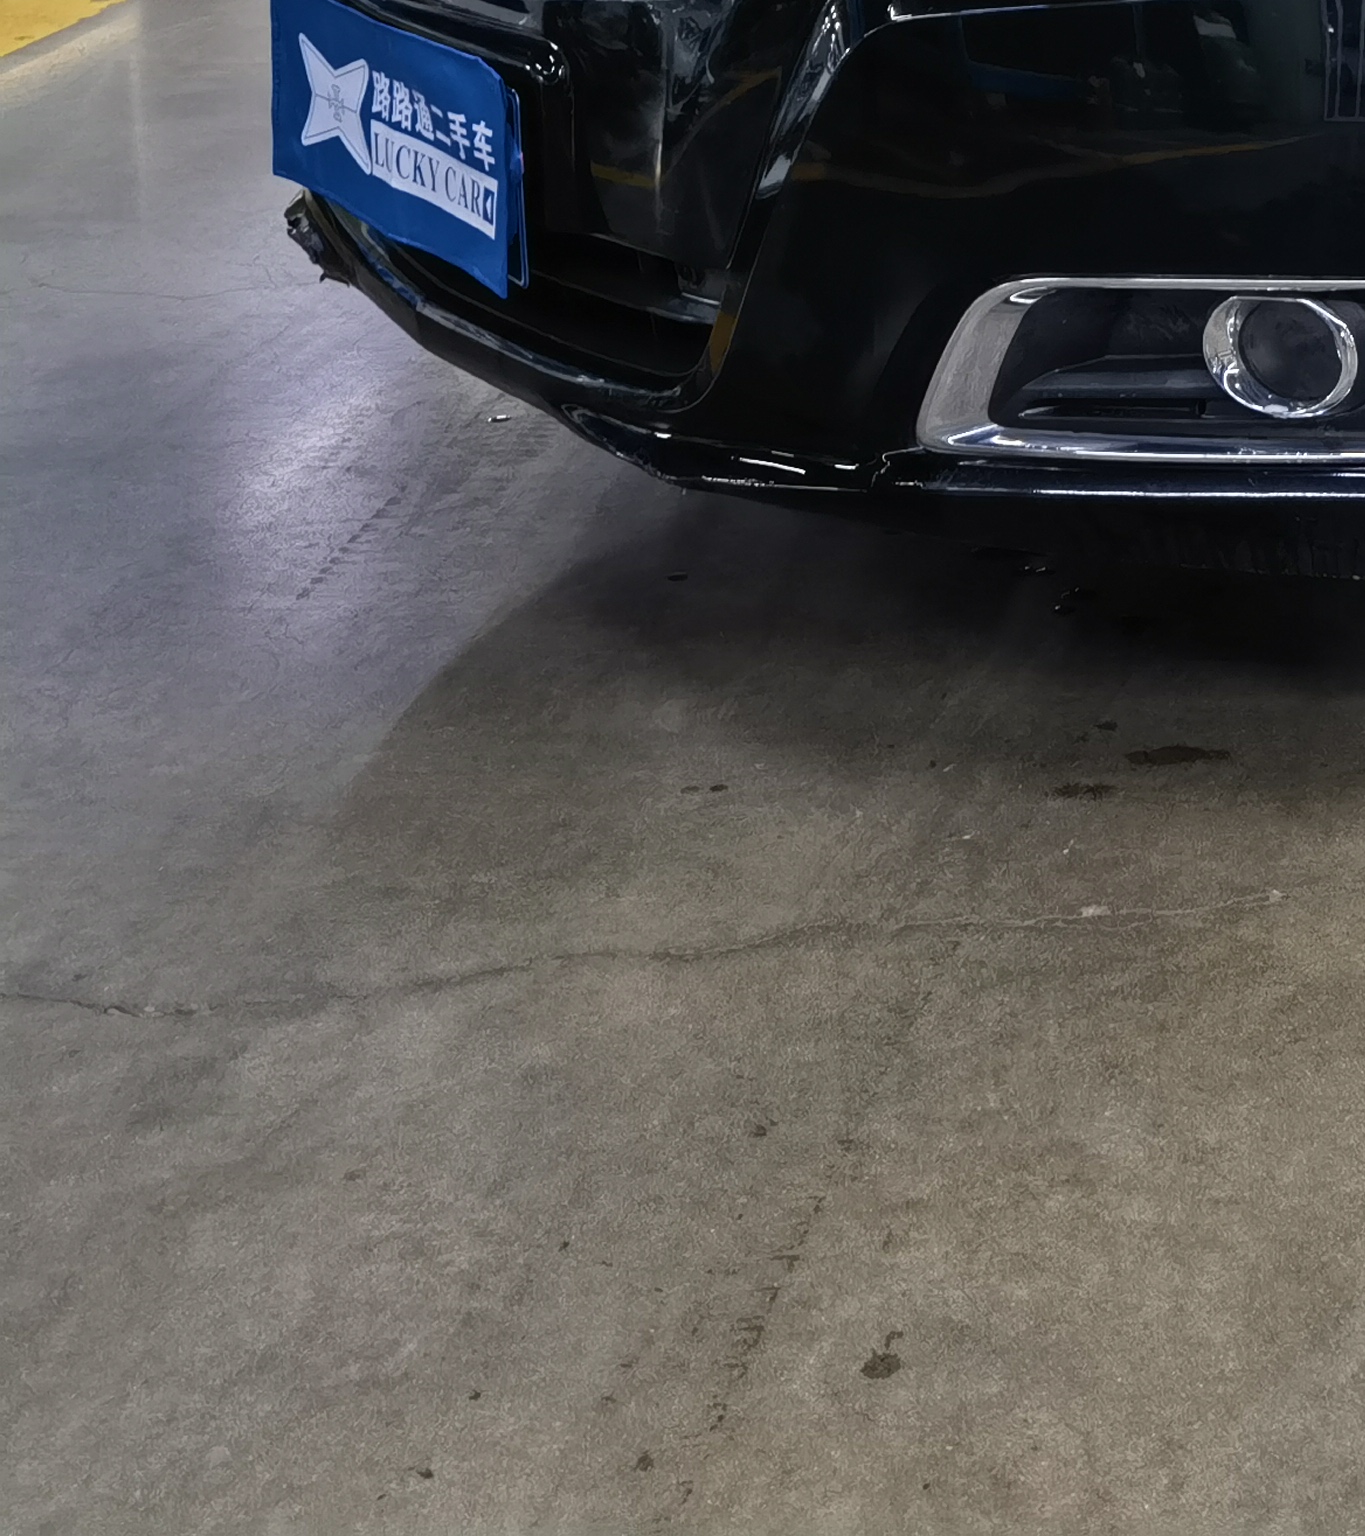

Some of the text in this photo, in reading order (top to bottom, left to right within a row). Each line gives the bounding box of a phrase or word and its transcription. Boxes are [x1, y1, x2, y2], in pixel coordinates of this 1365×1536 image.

[372, 70, 497, 172] 路路通二手车
[373, 131, 483, 218] LUCKY CAR
